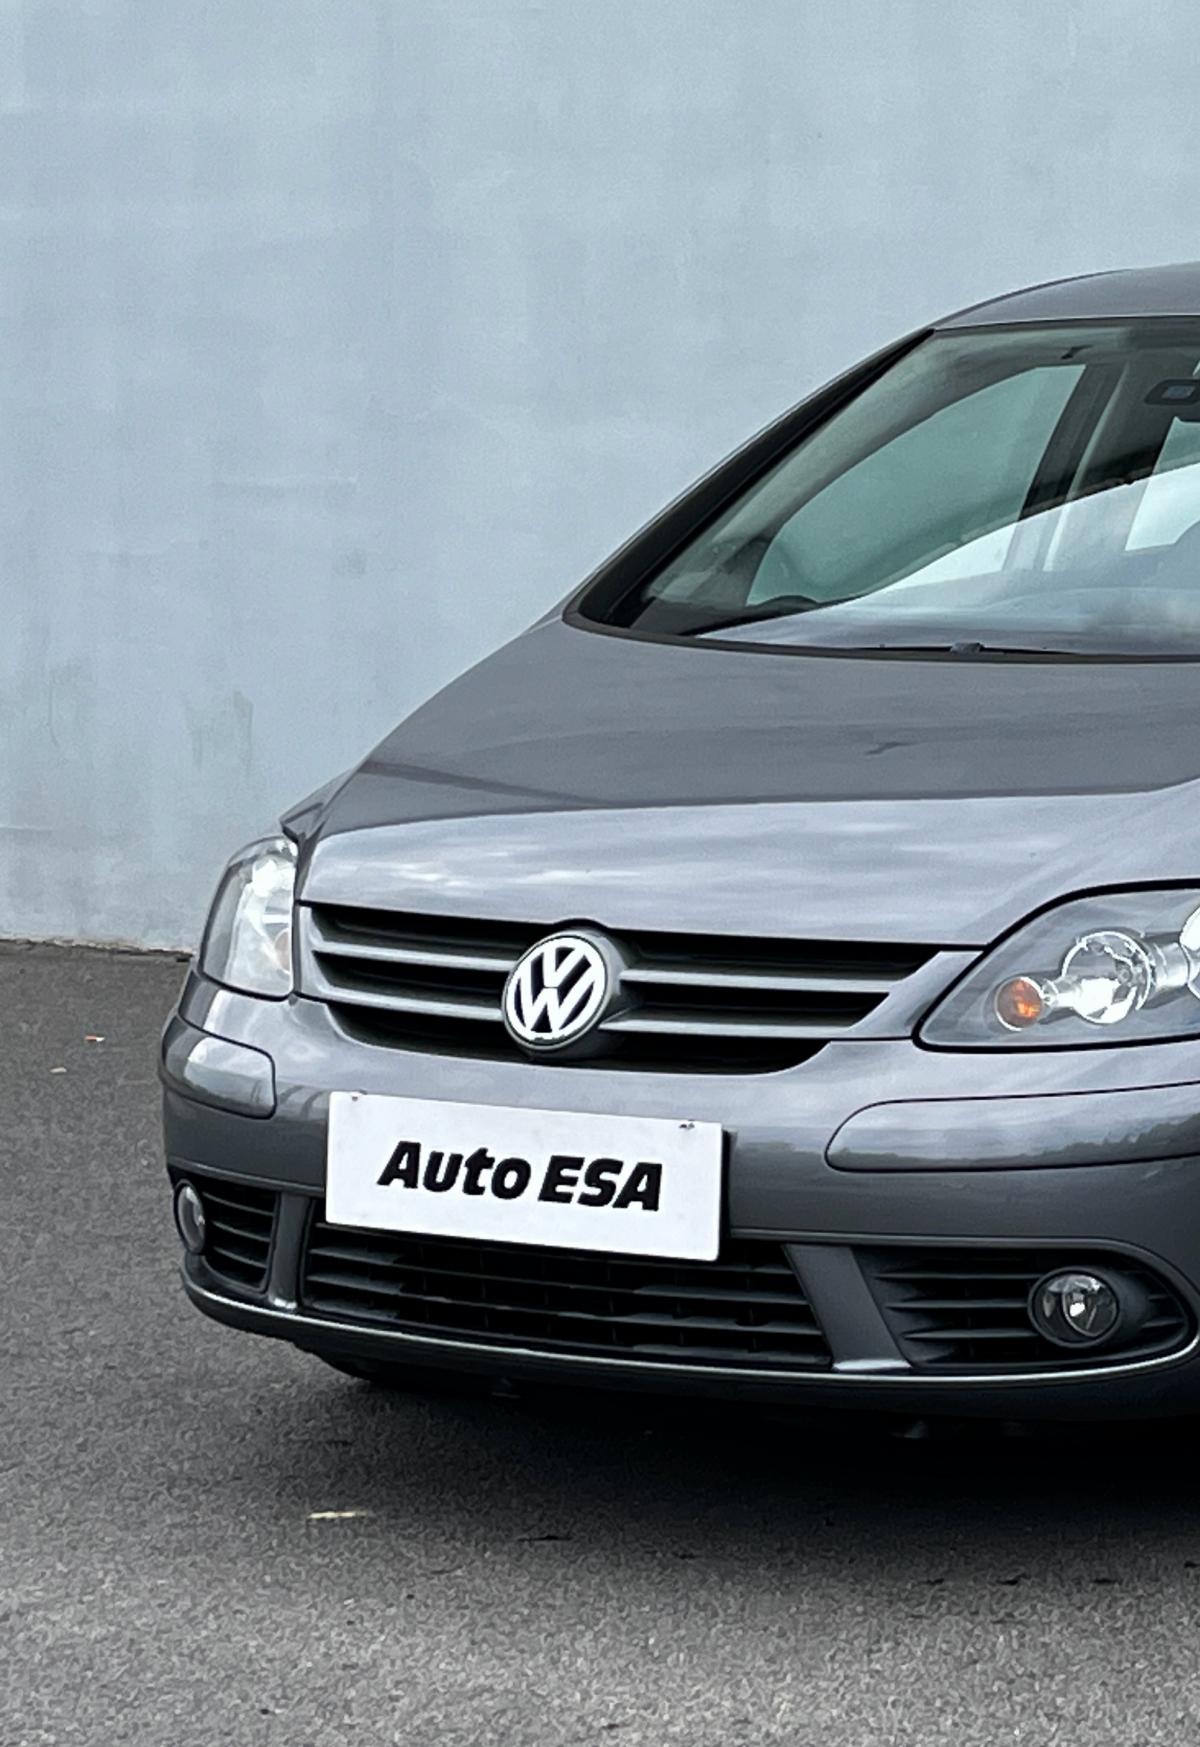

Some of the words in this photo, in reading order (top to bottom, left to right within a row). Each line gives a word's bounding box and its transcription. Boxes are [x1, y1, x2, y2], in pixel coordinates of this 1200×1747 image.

[507, 937, 605, 1039] VW
[377, 1140, 532, 1199] Auto
[538, 1155, 663, 1211] ESA
